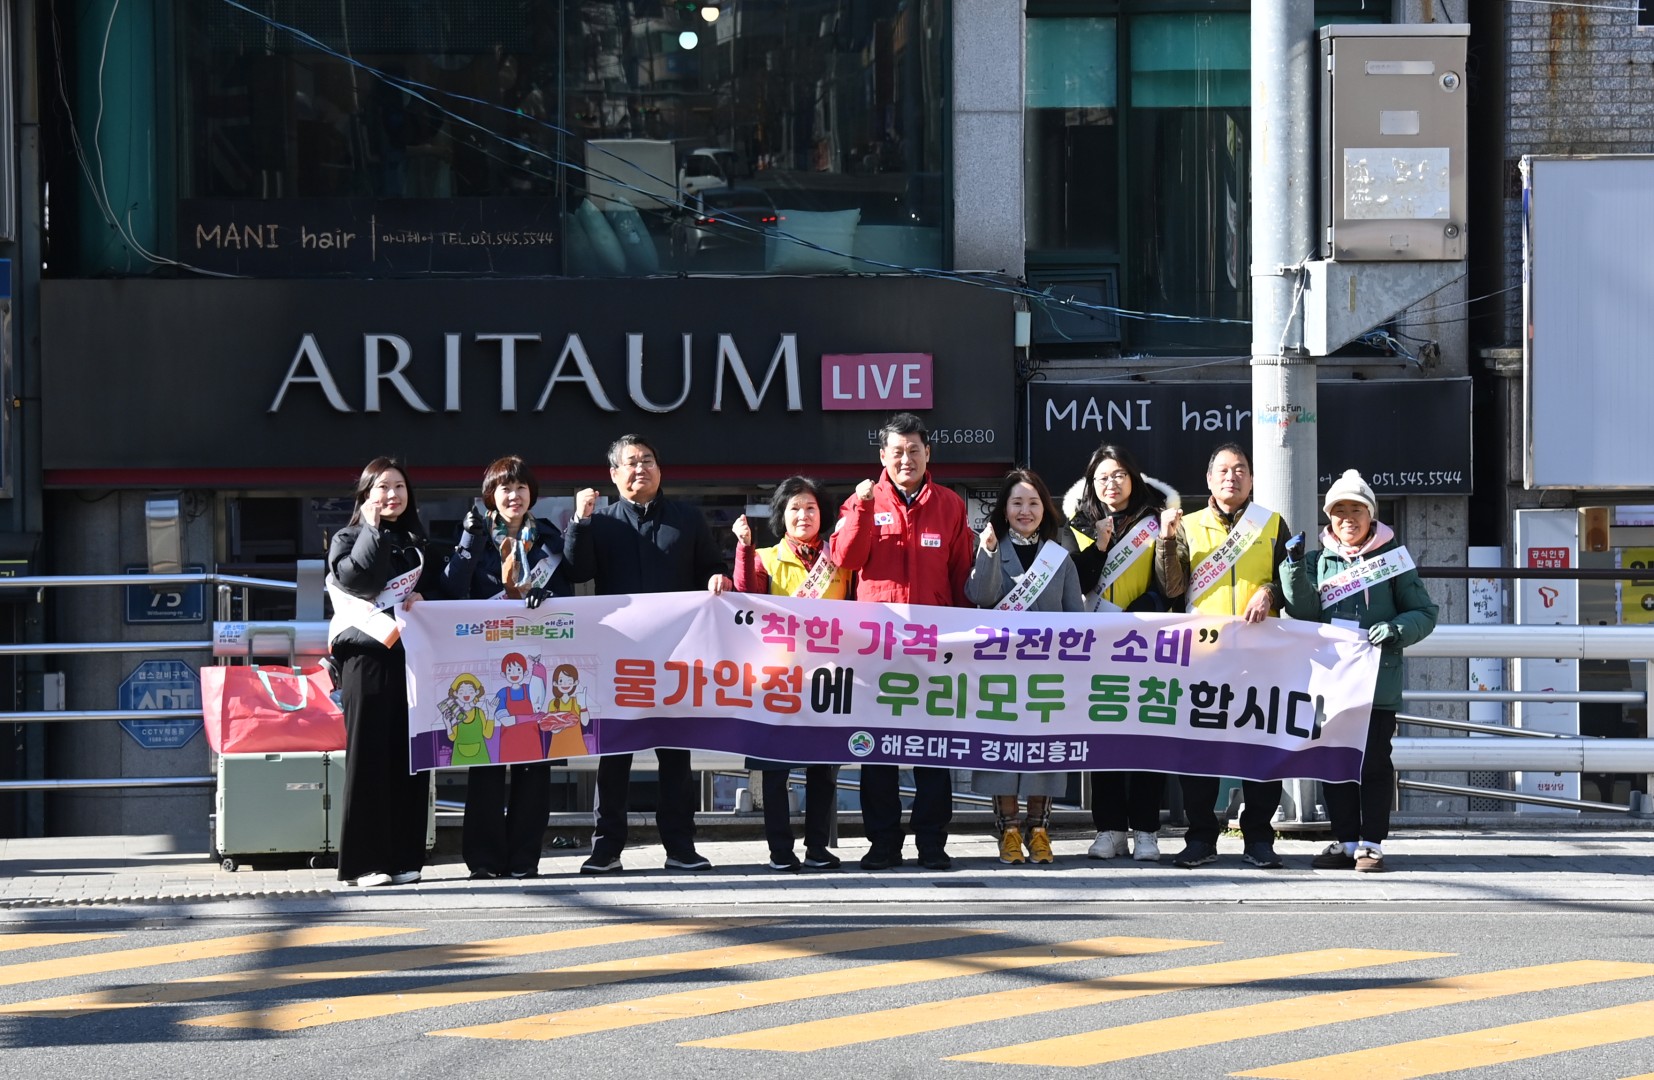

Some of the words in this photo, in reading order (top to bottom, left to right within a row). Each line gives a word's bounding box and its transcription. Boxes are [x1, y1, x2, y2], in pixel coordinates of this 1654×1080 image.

[196, 222, 279, 249] MANI
[302, 225, 356, 249] hair
[268, 332, 804, 414] ARITAUM
[831, 364, 923, 400] LIVE
[1045, 397, 1152, 432] MANI
[1181, 401, 1251, 432] hair
[927, 429, 995, 444] 45.6880
[1099, 545, 1134, 580] 보내세요
[1211, 531, 1243, 564] 전통시장
[1224, 531, 1254, 564] 시장에서
[1532, 550, 1566, 559] 공식인증
[1536, 559, 1562, 568] 판매점
[1193, 561, 1228, 593] 장보GO!
[1350, 557, 1388, 580] 전통시장
[1362, 563, 1400, 585] 시장에서
[1008, 571, 1039, 605] 전통시장
[1021, 571, 1050, 604] 시장에서
[857, 621, 953, 664] 가격,
[973, 627, 1096, 662] 건전한
[138, 688, 194, 709] ADT
[613, 658, 854, 715] 물가안정에
[876, 671, 1066, 723] 우리모두
[1088, 673, 1326, 741] 동참합시다
[881, 735, 971, 761] 해운대구
[981, 740, 1089, 764] 경제진흥과
[1537, 781, 1565, 791] 친절상담
